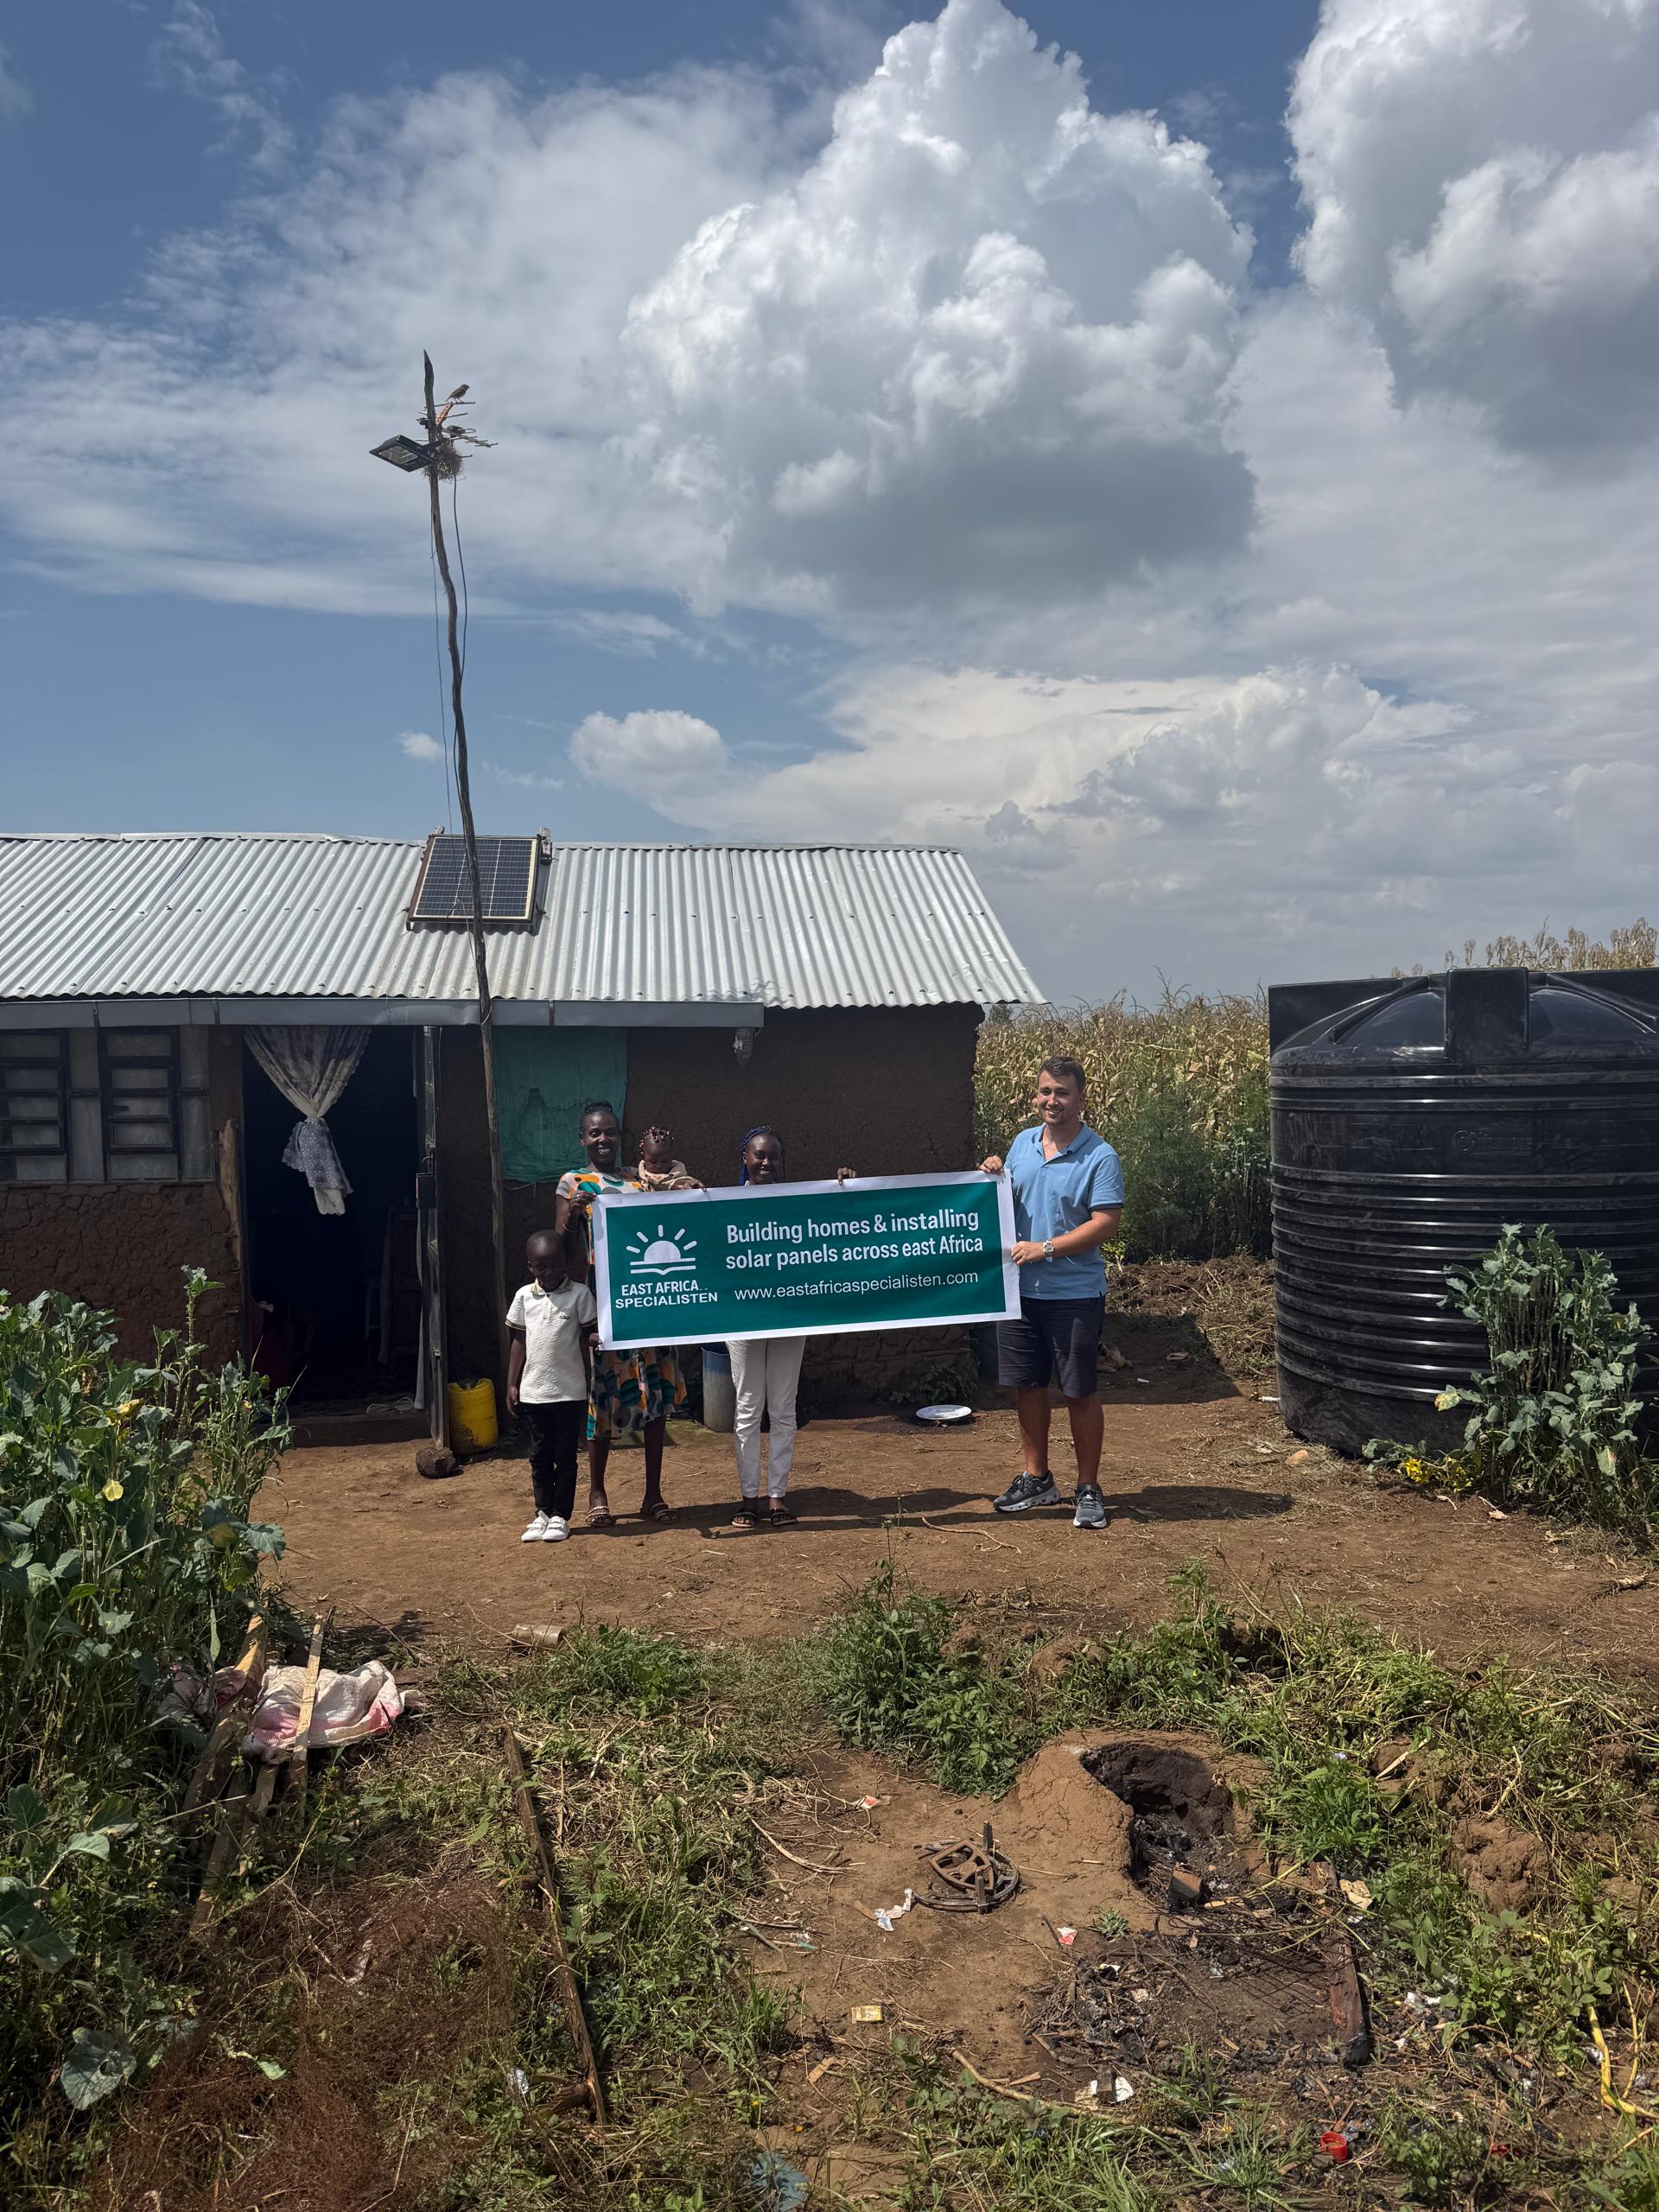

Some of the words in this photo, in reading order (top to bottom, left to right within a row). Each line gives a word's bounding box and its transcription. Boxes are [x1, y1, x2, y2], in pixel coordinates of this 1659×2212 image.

[727, 1221, 802, 1244] Building
[807, 1218, 871, 1238] homes
[874, 1214, 887, 1233] &
[891, 1208, 979, 1232] installing
[726, 1249, 772, 1270] solar
[777, 1243, 838, 1271] panels
[842, 1244, 899, 1262] across
[902, 1237, 937, 1258] east
[939, 1233, 983, 1255] Africa
[621, 1282, 653, 1297] EAST
[734, 1272, 978, 1300] www.eastafricaspecialisten.com
[615, 1292, 718, 1309] SPECIALISTEN
